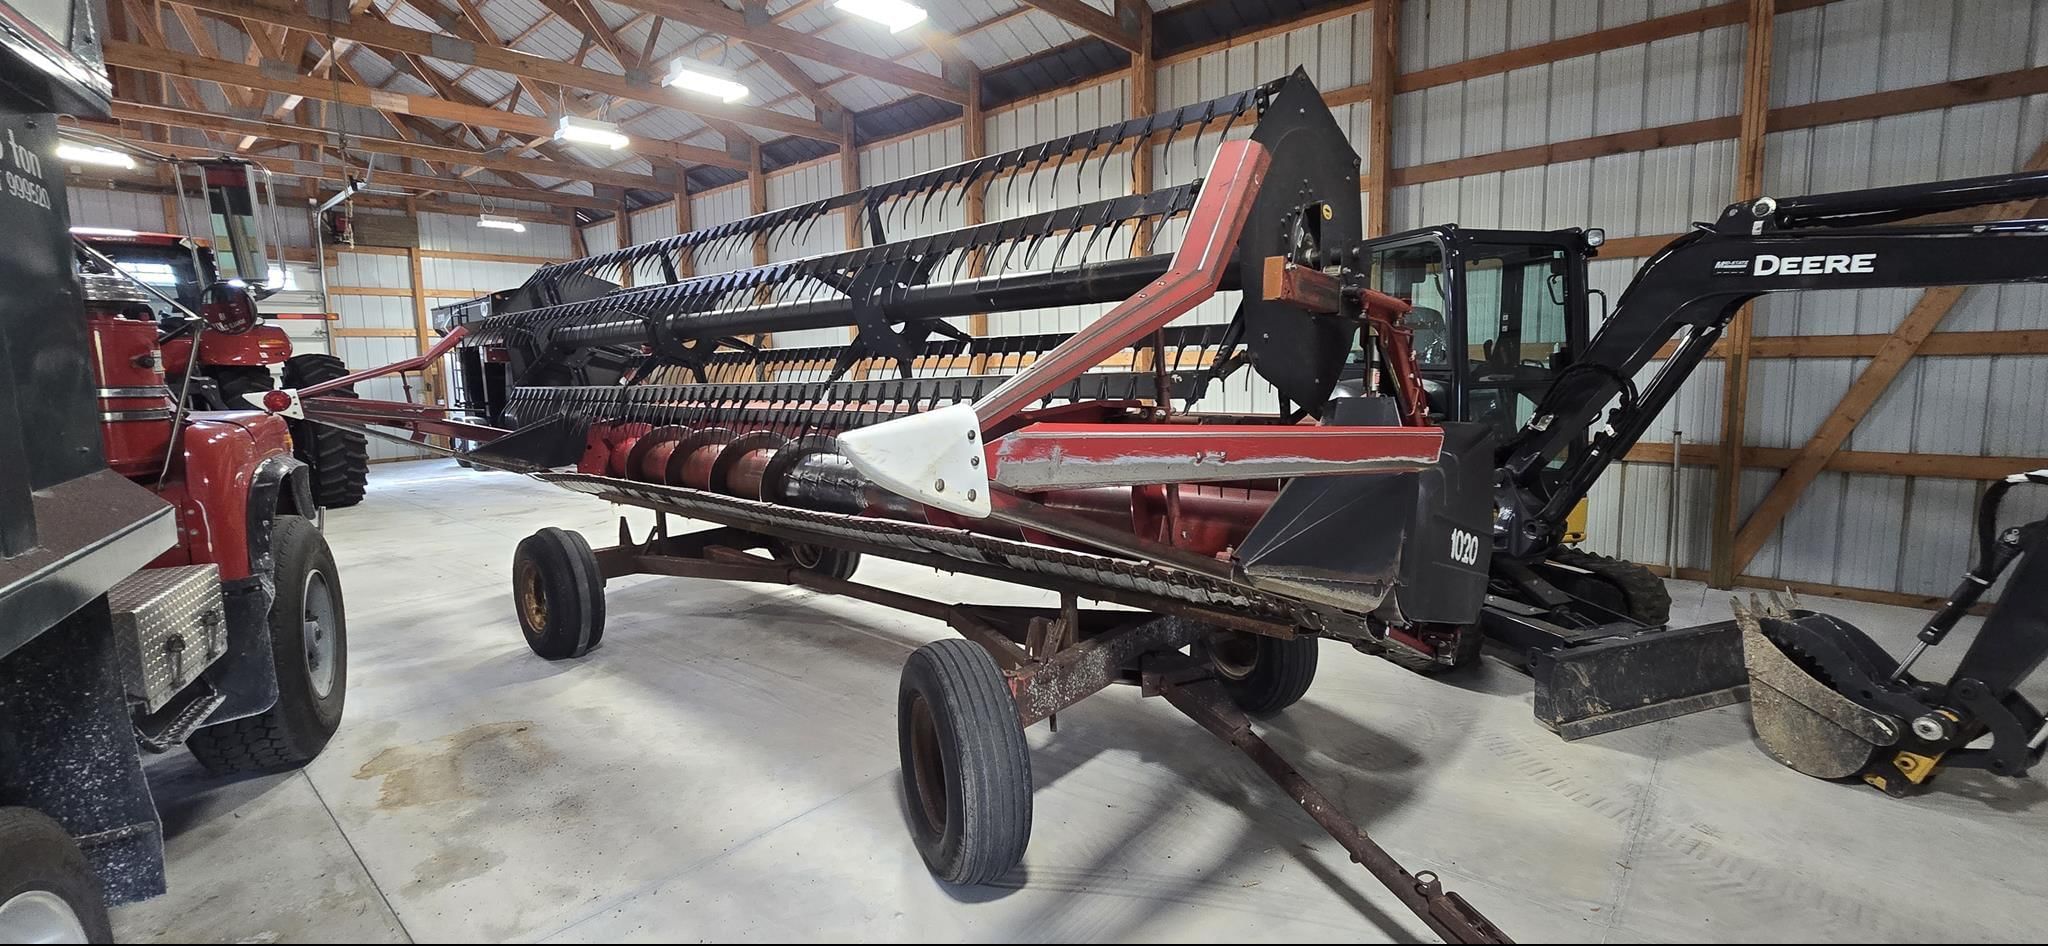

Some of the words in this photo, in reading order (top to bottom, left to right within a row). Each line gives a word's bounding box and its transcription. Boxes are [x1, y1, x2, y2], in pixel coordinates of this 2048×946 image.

[8, 128, 42, 179] ton
[6, 171, 51, 209] 999520
[1753, 253, 1877, 276] DEERE
[1450, 528, 1478, 566] 1020
